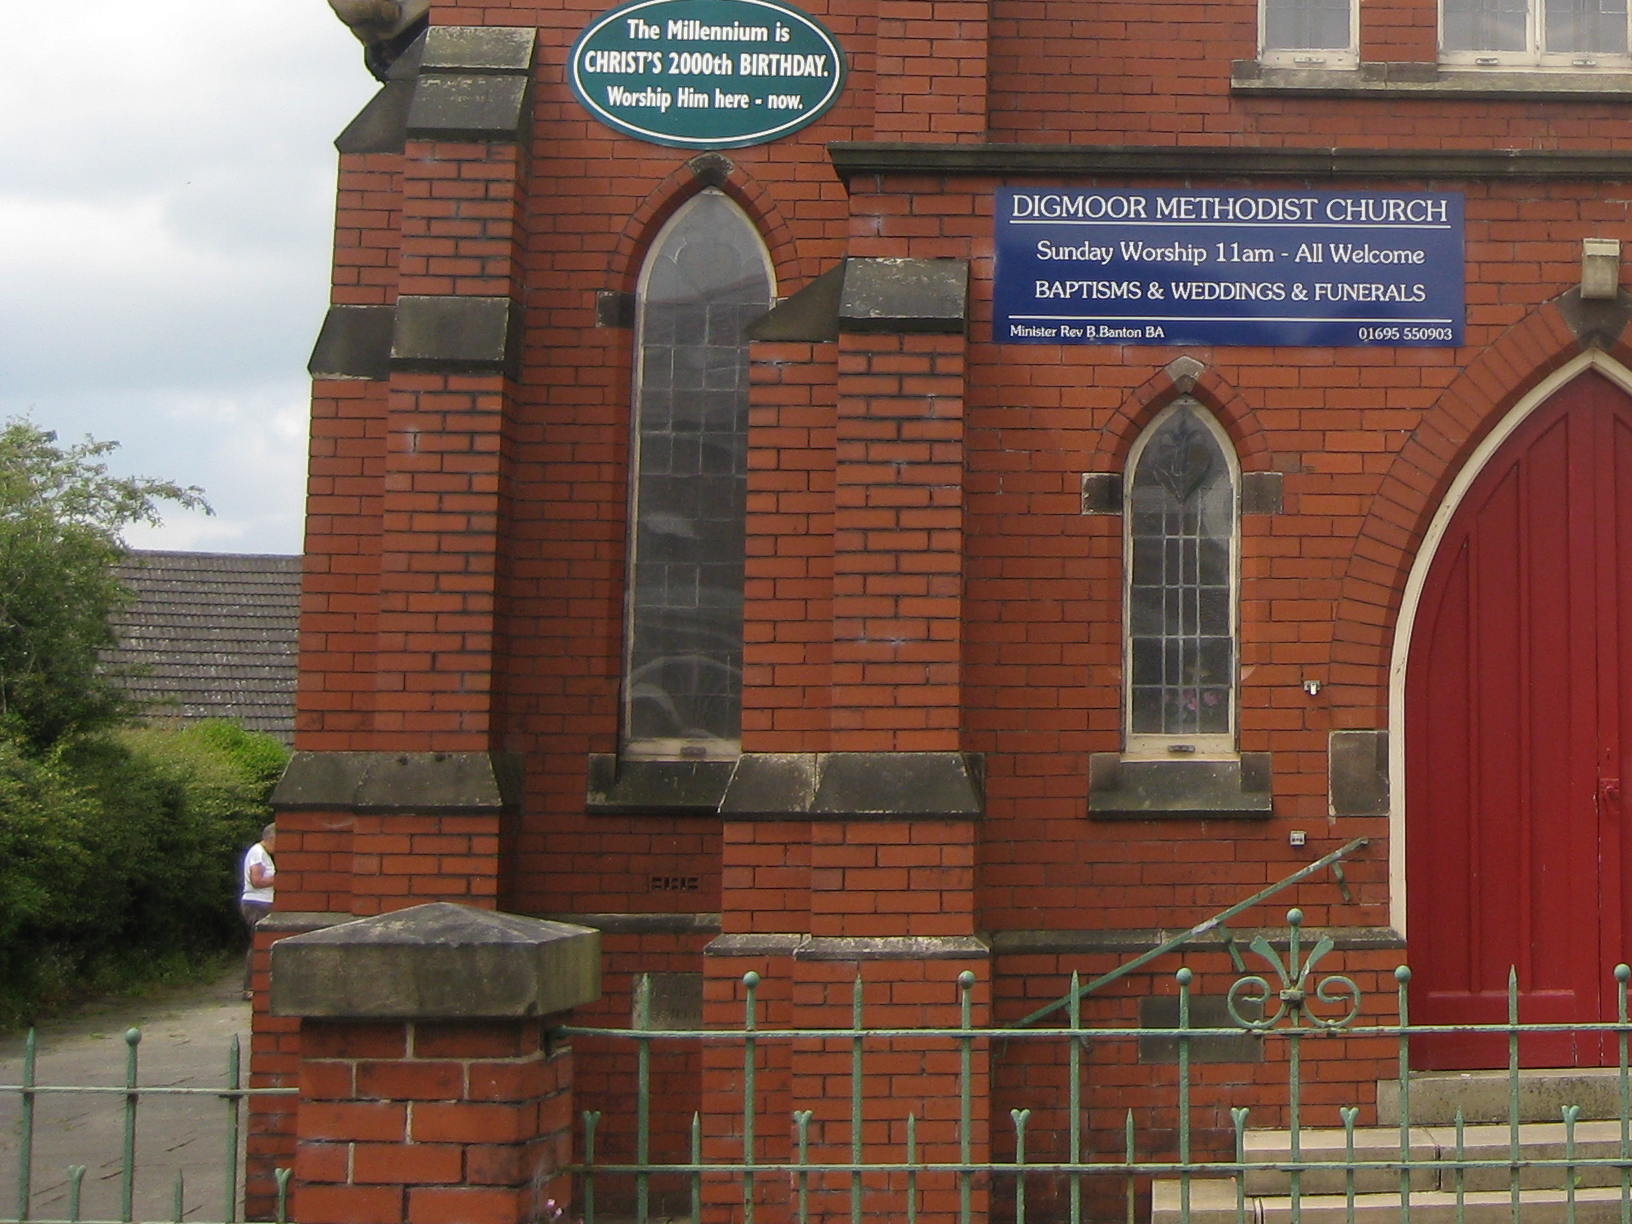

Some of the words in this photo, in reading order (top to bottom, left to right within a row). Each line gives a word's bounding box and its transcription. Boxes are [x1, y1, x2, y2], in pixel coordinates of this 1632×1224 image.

[627, 19, 660, 40] The
[667, 20, 768, 42] Millennium
[775, 22, 791, 42] is
[668, 52, 732, 75] 2000th
[740, 54, 829, 77] BIRTHDAY.
[607, 86, 671, 112] Worship
[677, 88, 708, 107] Him
[715, 90, 749, 108] here
[767, 94, 803, 109] now.
[1012, 195, 1147, 218] DIGMOOR
[1156, 197, 1318, 221] METHODIST
[1326, 199, 1448, 222] CHURCH
[1036, 241, 1113, 264] Sunday
[1120, 242, 1207, 265] Worship
[1216, 243, 1274, 263] 11am
[1295, 243, 1323, 263] All
[1329, 244, 1425, 264] Welcome
[1035, 281, 1142, 300] BAPTISMS
[1147, 282, 1165, 301] &
[1171, 282, 1286, 302] WEDDINGS
[1291, 283, 1309, 302] &
[1315, 284, 1426, 303] FUNERALS
[1010, 325, 1056, 337] Minister
[1060, 325, 1083, 338] Rev
[1146, 326, 1164, 338] BA
[1359, 328, 1399, 340] 01695
[1403, 328, 1453, 341] 550903
